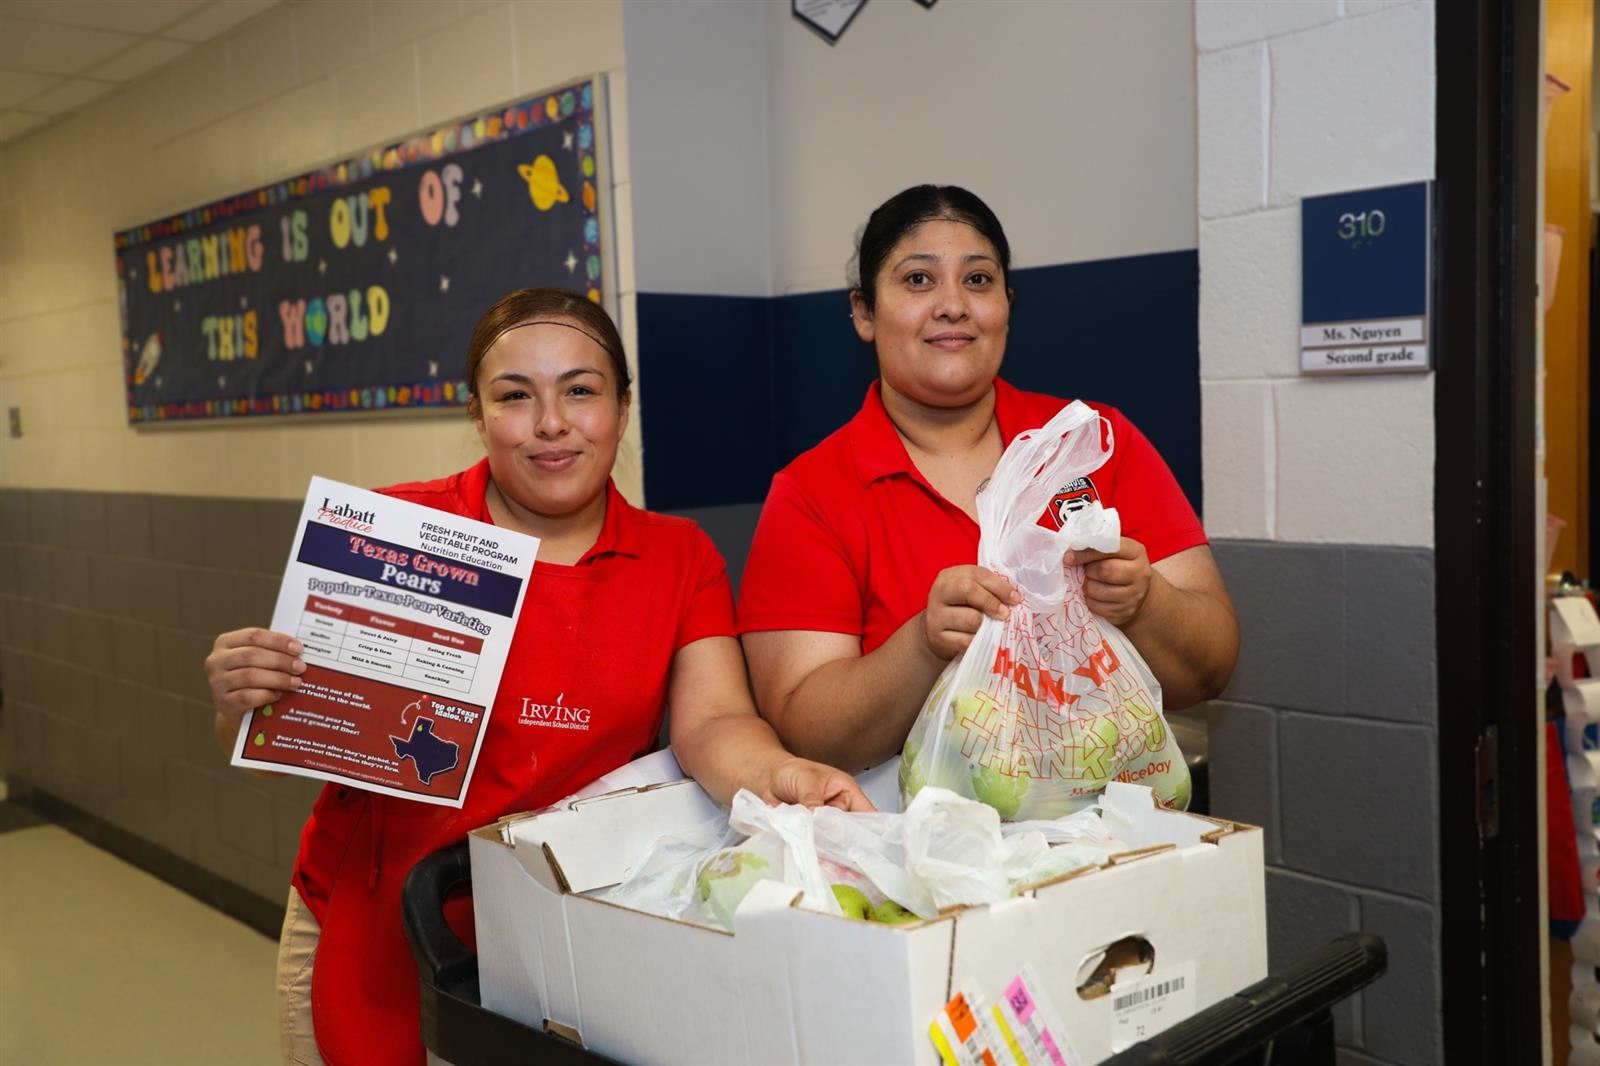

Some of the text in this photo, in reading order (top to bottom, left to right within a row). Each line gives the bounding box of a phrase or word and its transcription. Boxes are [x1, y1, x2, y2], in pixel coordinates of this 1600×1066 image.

[147, 163, 464, 293] LEARNING IS OUT OF
[1338, 210, 1385, 239] 310
[203, 285, 390, 361] THIS WORLD
[1323, 327, 1401, 340] Ms. Nguyen
[1326, 346, 1414, 364] Second grade
[317, 506, 373, 533] Produce
[322, 497, 376, 525] Labatt
[420, 531, 518, 565] VEGETABLE PROGRAM
[421, 522, 499, 549] FRESH FRUIT AND
[349, 535, 479, 586] Texas Grown
[421, 543, 502, 571] Nutrition Education
[380, 563, 442, 594] Pears
[308, 578, 491, 636] Popular Texas Pear Varieties
[358, 643, 374, 652] Crisp
[416, 658, 435, 667] Baking
[442, 664, 465, 674] Canning
[427, 647, 445, 655] Eating
[446, 651, 462, 659] Fresh
[300, 681, 316, 689] ears
[370, 660, 392, 669] Smooth
[424, 674, 450, 684] Snacking
[307, 690, 327, 699] fruits
[431, 701, 445, 710] Top
[457, 708, 479, 718] Texas
[518, 717, 589, 731] Independent School District
[294, 737, 311, 746] ripen
[345, 747, 366, 758] they're
[300, 745, 324, 755] harvest
[325, 750, 341, 758] them
[343, 755, 359, 764] when
[361, 759, 383, 769] they're
[960, 716, 1108, 779] THANK
